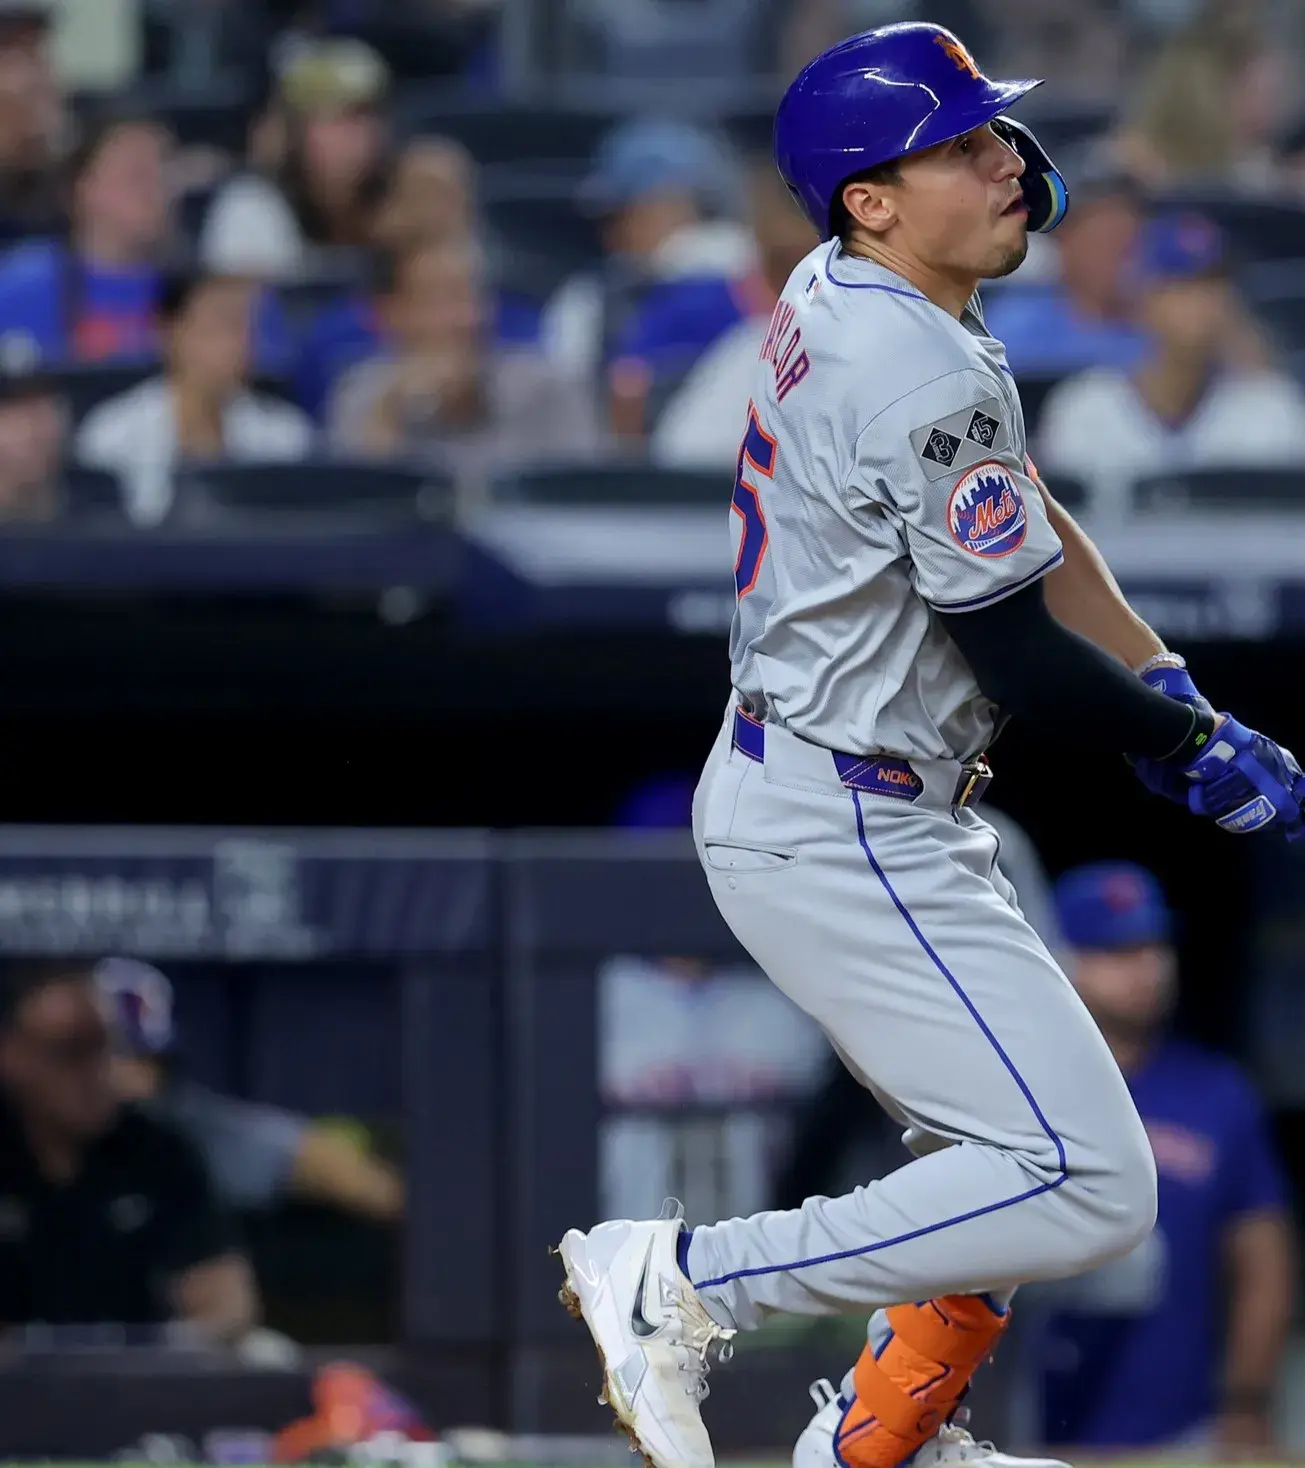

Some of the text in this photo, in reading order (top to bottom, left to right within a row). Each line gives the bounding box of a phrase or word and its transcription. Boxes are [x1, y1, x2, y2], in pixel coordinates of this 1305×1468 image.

[930, 432, 954, 463] 3
[973, 416, 994, 443] 15
[969, 489, 1017, 540] Mets
